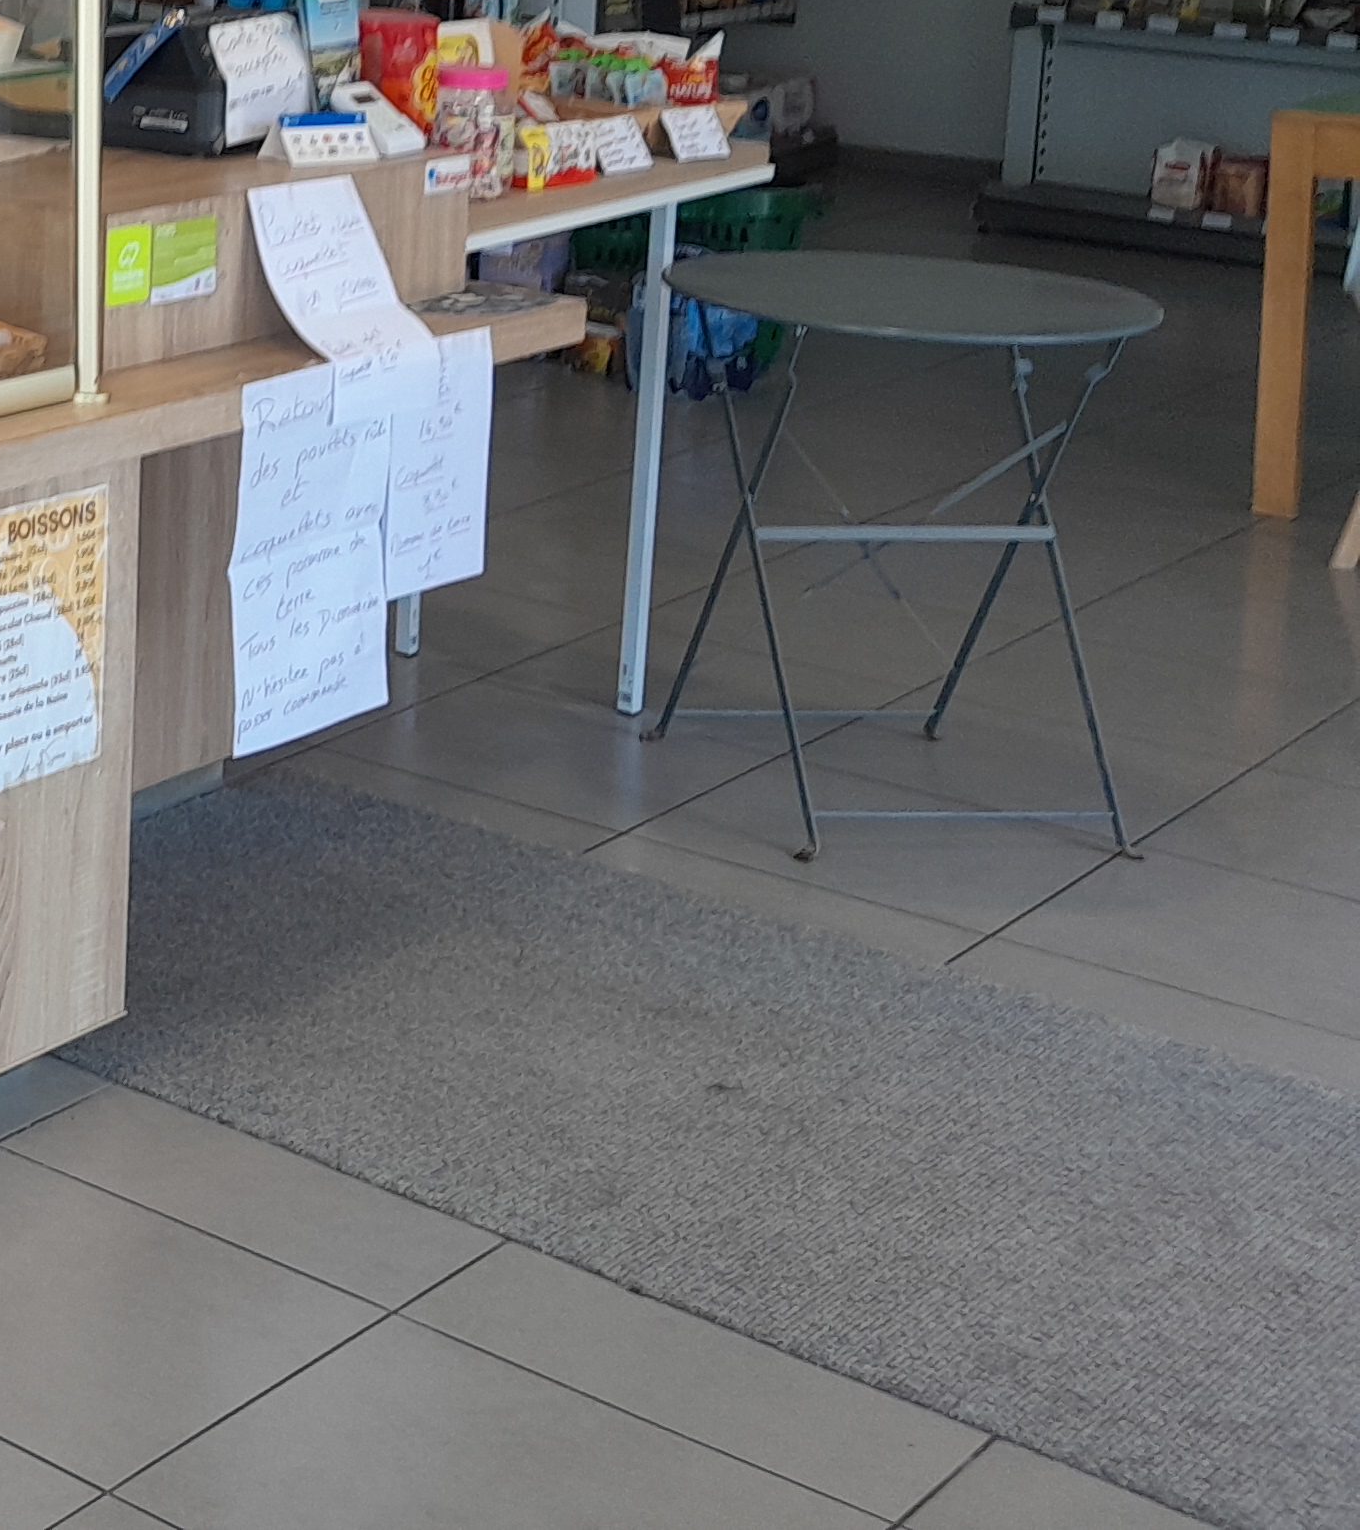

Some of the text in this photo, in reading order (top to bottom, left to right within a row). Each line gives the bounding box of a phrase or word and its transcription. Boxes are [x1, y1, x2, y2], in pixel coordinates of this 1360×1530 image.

[250, 452, 280, 488] des
[281, 475, 309, 508] et
[8, 500, 96, 545] BOISSONS
[240, 631, 276, 660] Tous
[290, 619, 310, 639] les
[318, 651, 344, 684] pas
